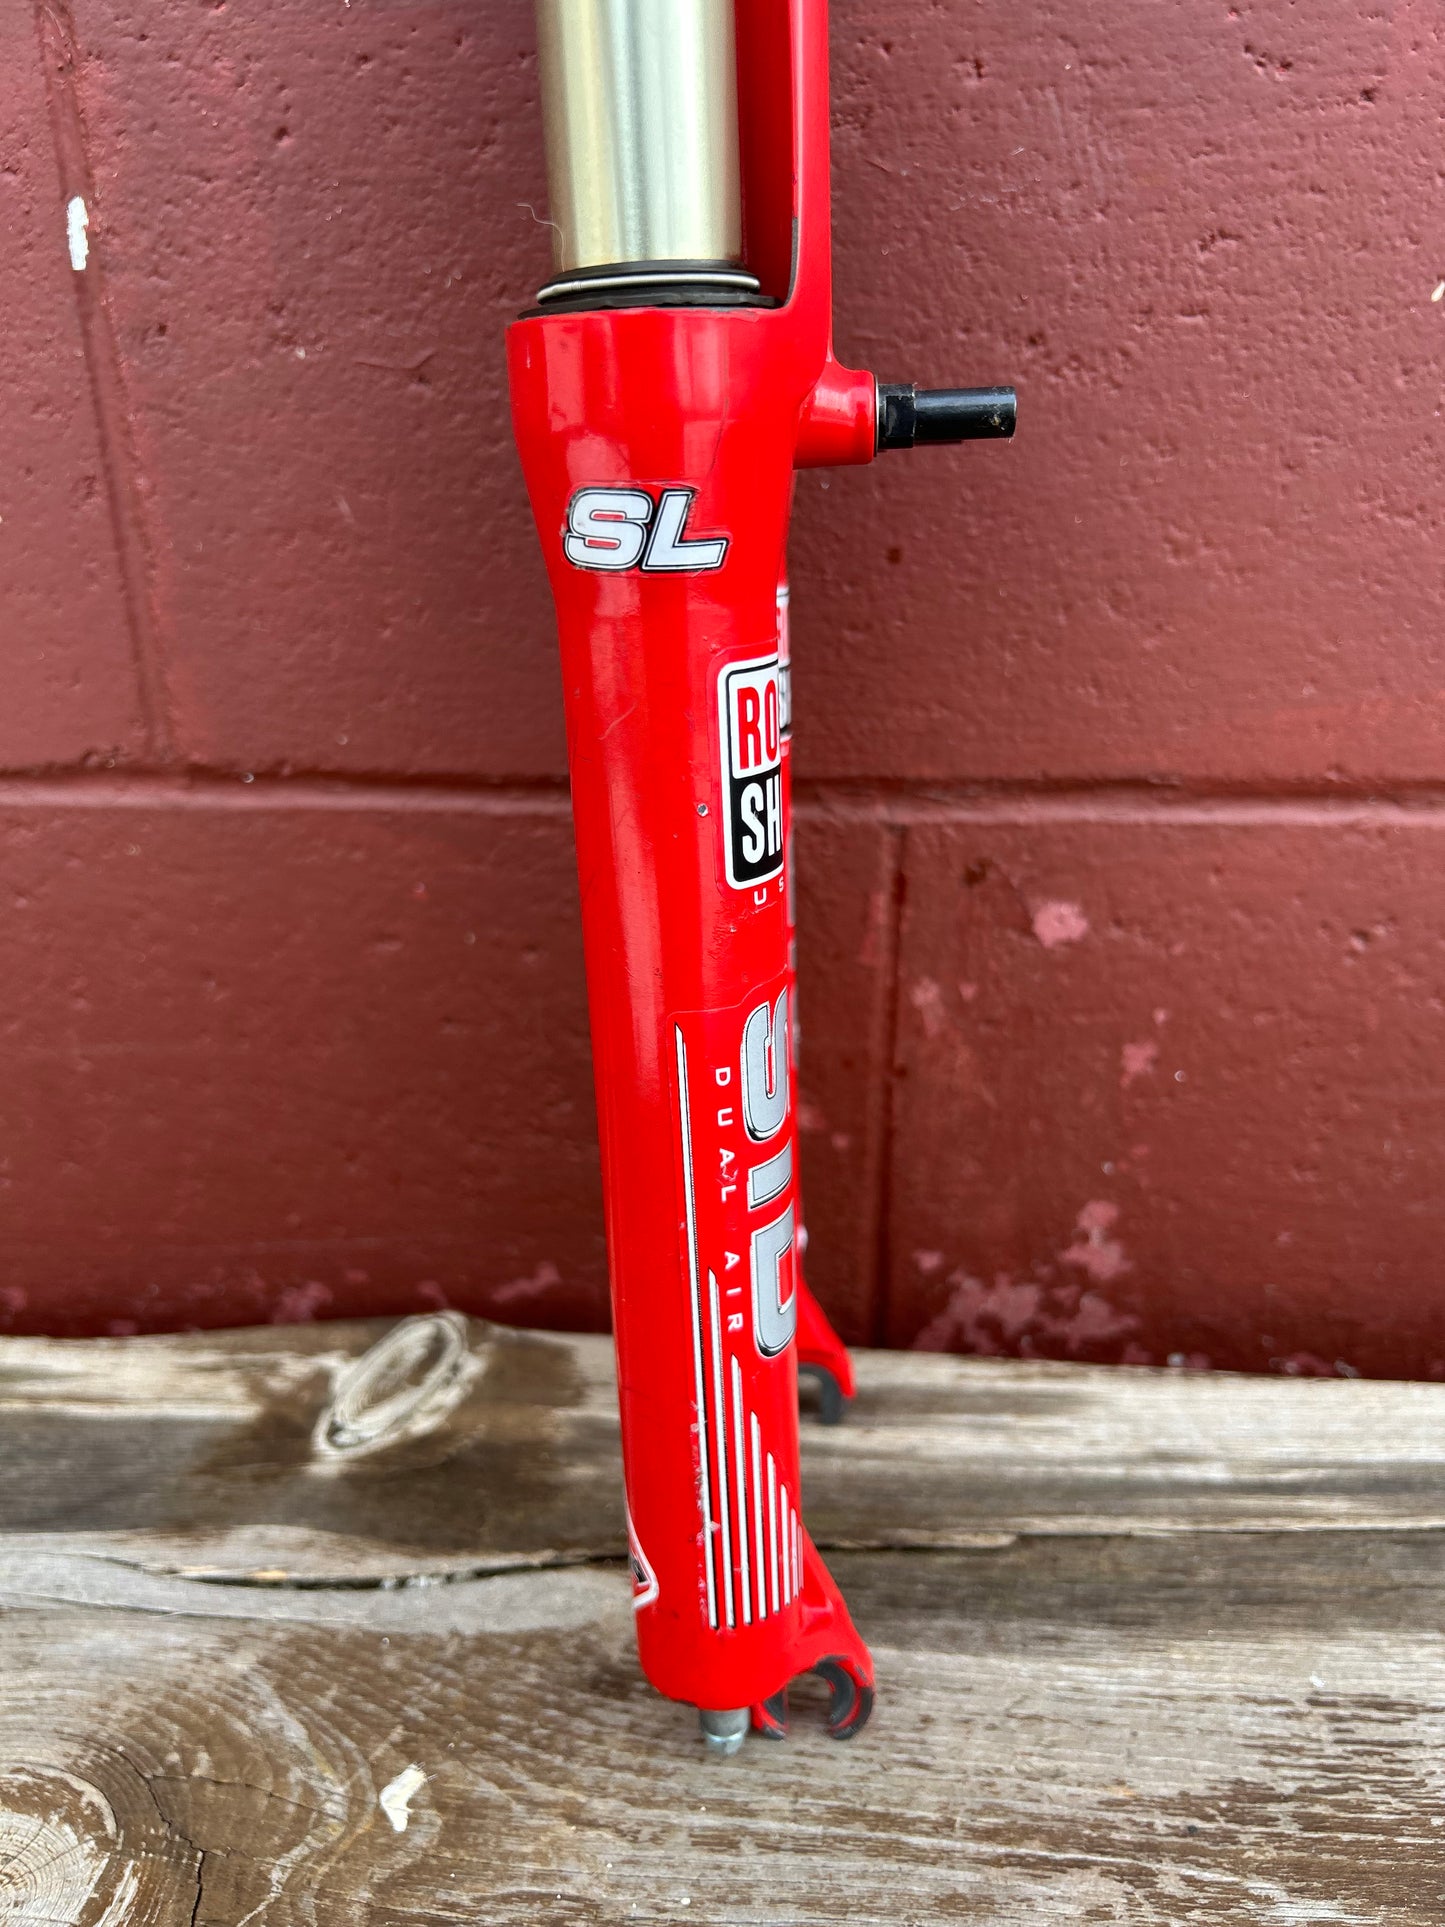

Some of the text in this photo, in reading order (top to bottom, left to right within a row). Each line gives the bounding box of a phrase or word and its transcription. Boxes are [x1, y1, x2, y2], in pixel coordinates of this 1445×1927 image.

[564, 487, 730, 573] SL
[737, 679, 779, 771] RO
[740, 774, 784, 864] SH
[753, 876, 784, 905] US
[714, 1066, 744, 1332] DUAL AIR
